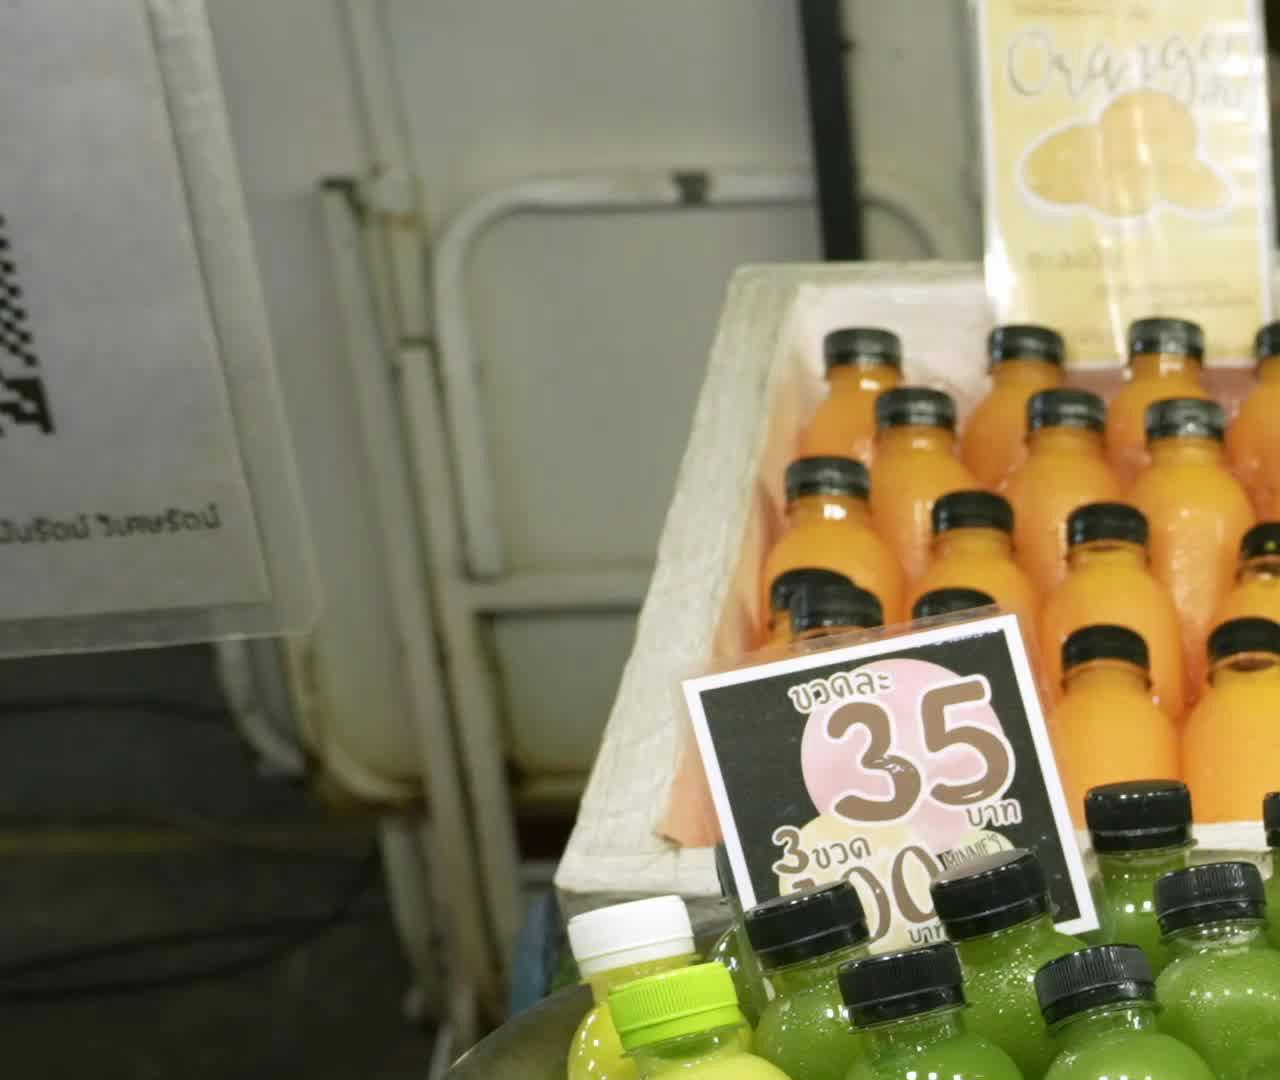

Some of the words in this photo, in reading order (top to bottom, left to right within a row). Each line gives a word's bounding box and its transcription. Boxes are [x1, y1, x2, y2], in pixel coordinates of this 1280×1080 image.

[790, 671, 890, 712] ขวดละ
[826, 678, 1010, 823] 35
[965, 801, 1020, 828] บาท
[774, 828, 809, 873] 3
[811, 836, 872, 869] ขวด
